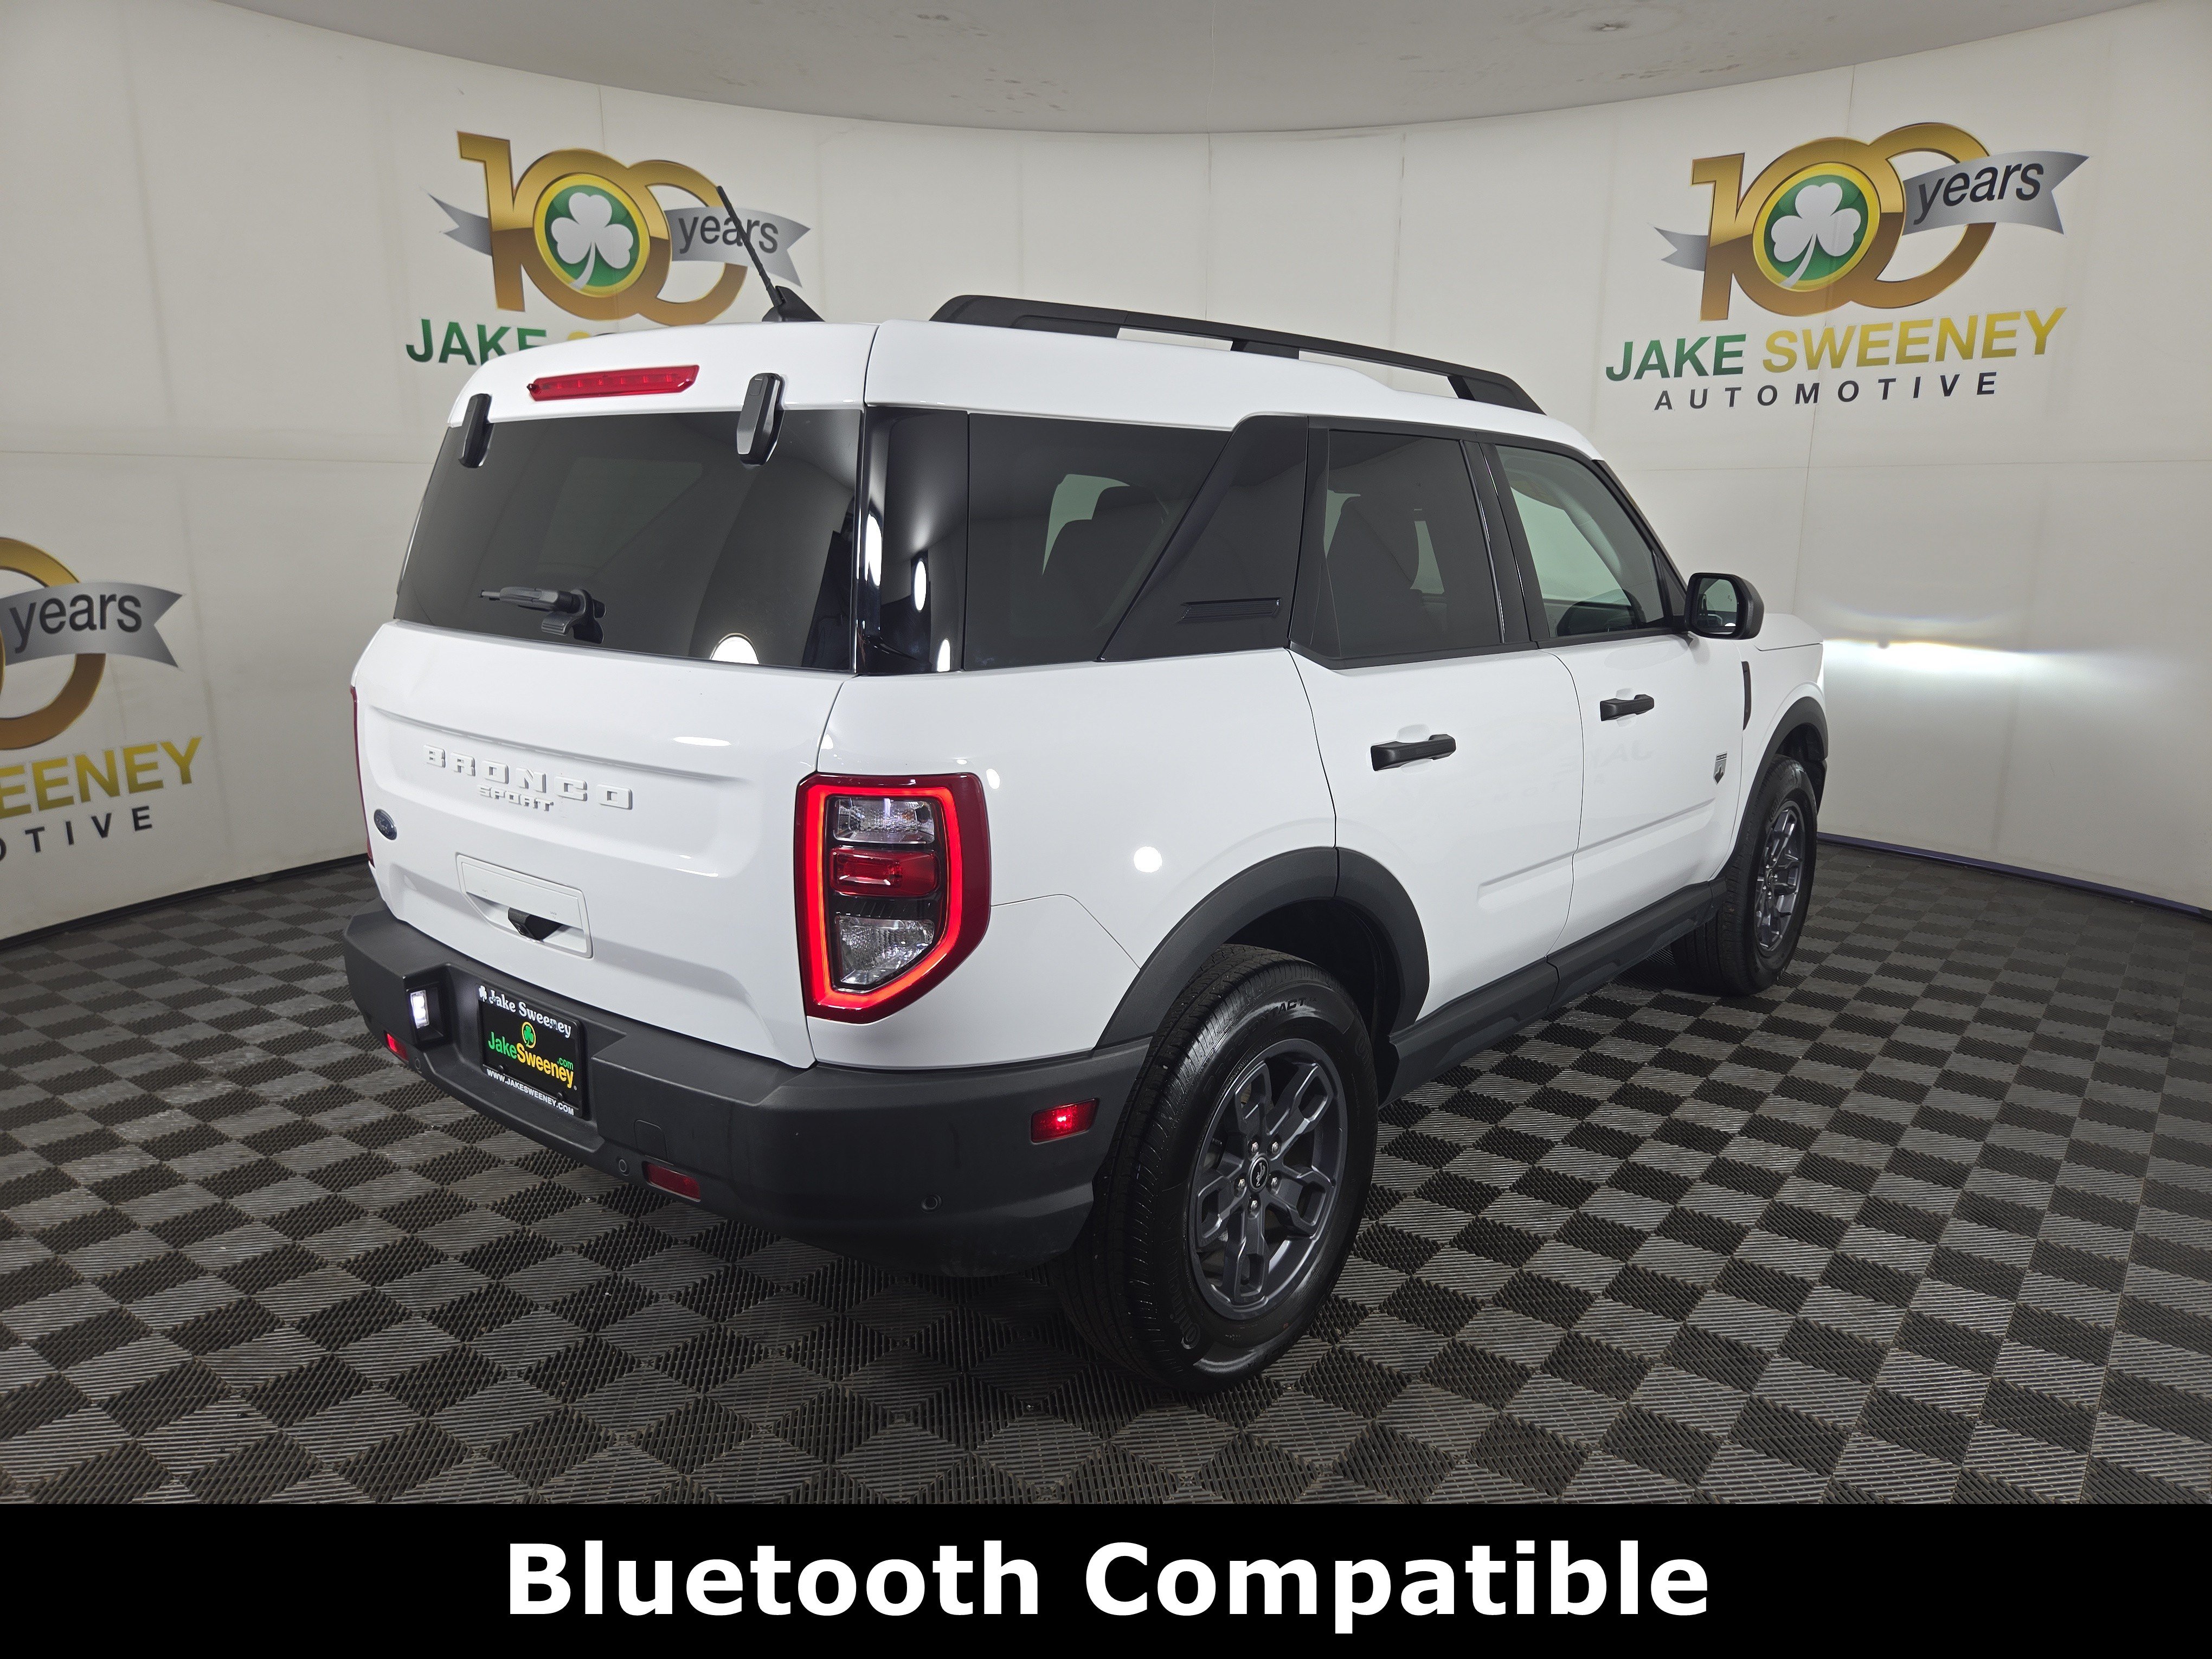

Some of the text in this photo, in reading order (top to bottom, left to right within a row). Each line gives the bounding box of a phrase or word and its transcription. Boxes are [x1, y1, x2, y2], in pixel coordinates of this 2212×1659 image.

[1913, 161, 2044, 225] years
[457, 131, 748, 326] 100
[678, 215, 779, 254] years
[1690, 122, 1998, 321] 100
[406, 318, 548, 366] JAKE
[1605, 306, 2068, 382] JAKE SWEENEY
[1654, 371, 1997, 411] AUTOMOTIVE
[9, 593, 143, 654] years
[423, 744, 633, 810] BRONCO
[477, 784, 554, 812] SPORT
[488, 989, 572, 1038] Jake Sweeney
[486, 1068, 574, 1116] WWW.JAKESWEENEY.COM
